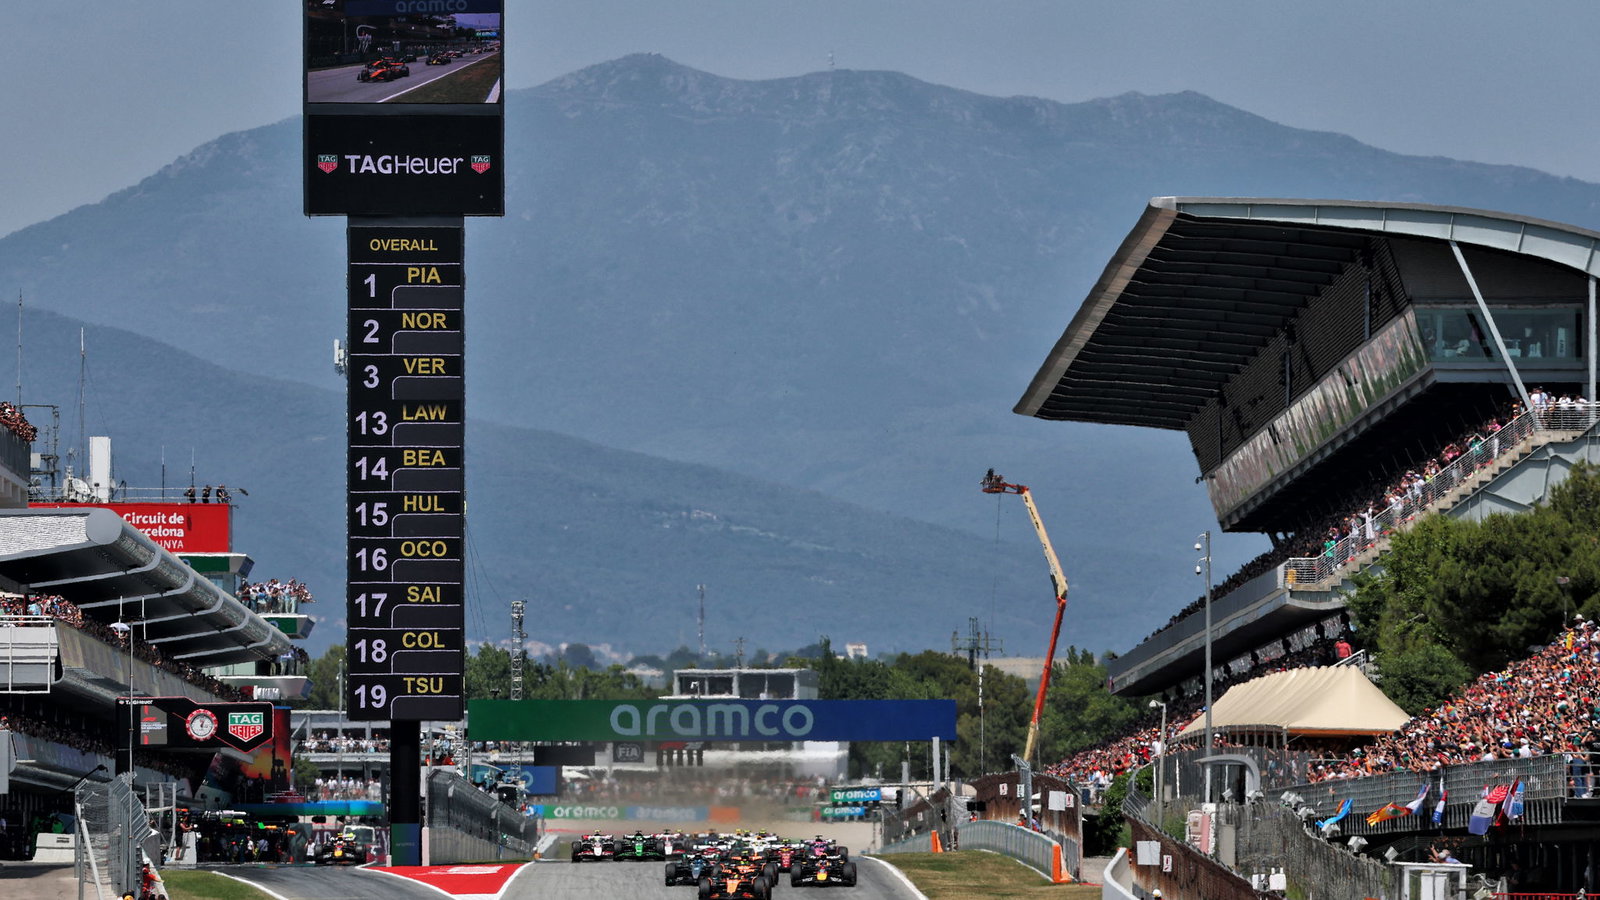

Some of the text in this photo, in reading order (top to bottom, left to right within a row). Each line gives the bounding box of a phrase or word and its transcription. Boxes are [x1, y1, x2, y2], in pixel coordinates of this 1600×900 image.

[320, 155, 337, 163] TAG
[472, 156, 489, 164] TAG
[369, 238, 438, 251] OVERALL
[407, 266, 442, 284] PIA
[364, 273, 376, 298] 1
[402, 312, 447, 329] NOR
[363, 319, 380, 343] 2
[403, 357, 446, 374] VER
[363, 364, 380, 389] 3
[402, 404, 447, 421] LAW
[355, 410, 388, 436] 13
[403, 449, 446, 466] BEA
[355, 456, 389, 481] 14
[403, 495, 445, 512] HUL
[122, 512, 185, 525] Circuit de
[355, 502, 389, 527] 15
[136, 525, 185, 538] rcelona
[400, 540, 448, 558] OCO
[355, 547, 388, 571] 16
[407, 586, 441, 603] SAI
[354, 592, 388, 618] 17
[401, 631, 446, 649] COL
[354, 638, 388, 663] 18
[402, 677, 443, 694] TSU
[354, 684, 387, 709] 19
[231, 713, 261, 724] TAG
[610, 705, 814, 736] aramco
[231, 725, 262, 740] HEUER
[833, 790, 878, 800] aramco
[554, 806, 619, 818] aramco
